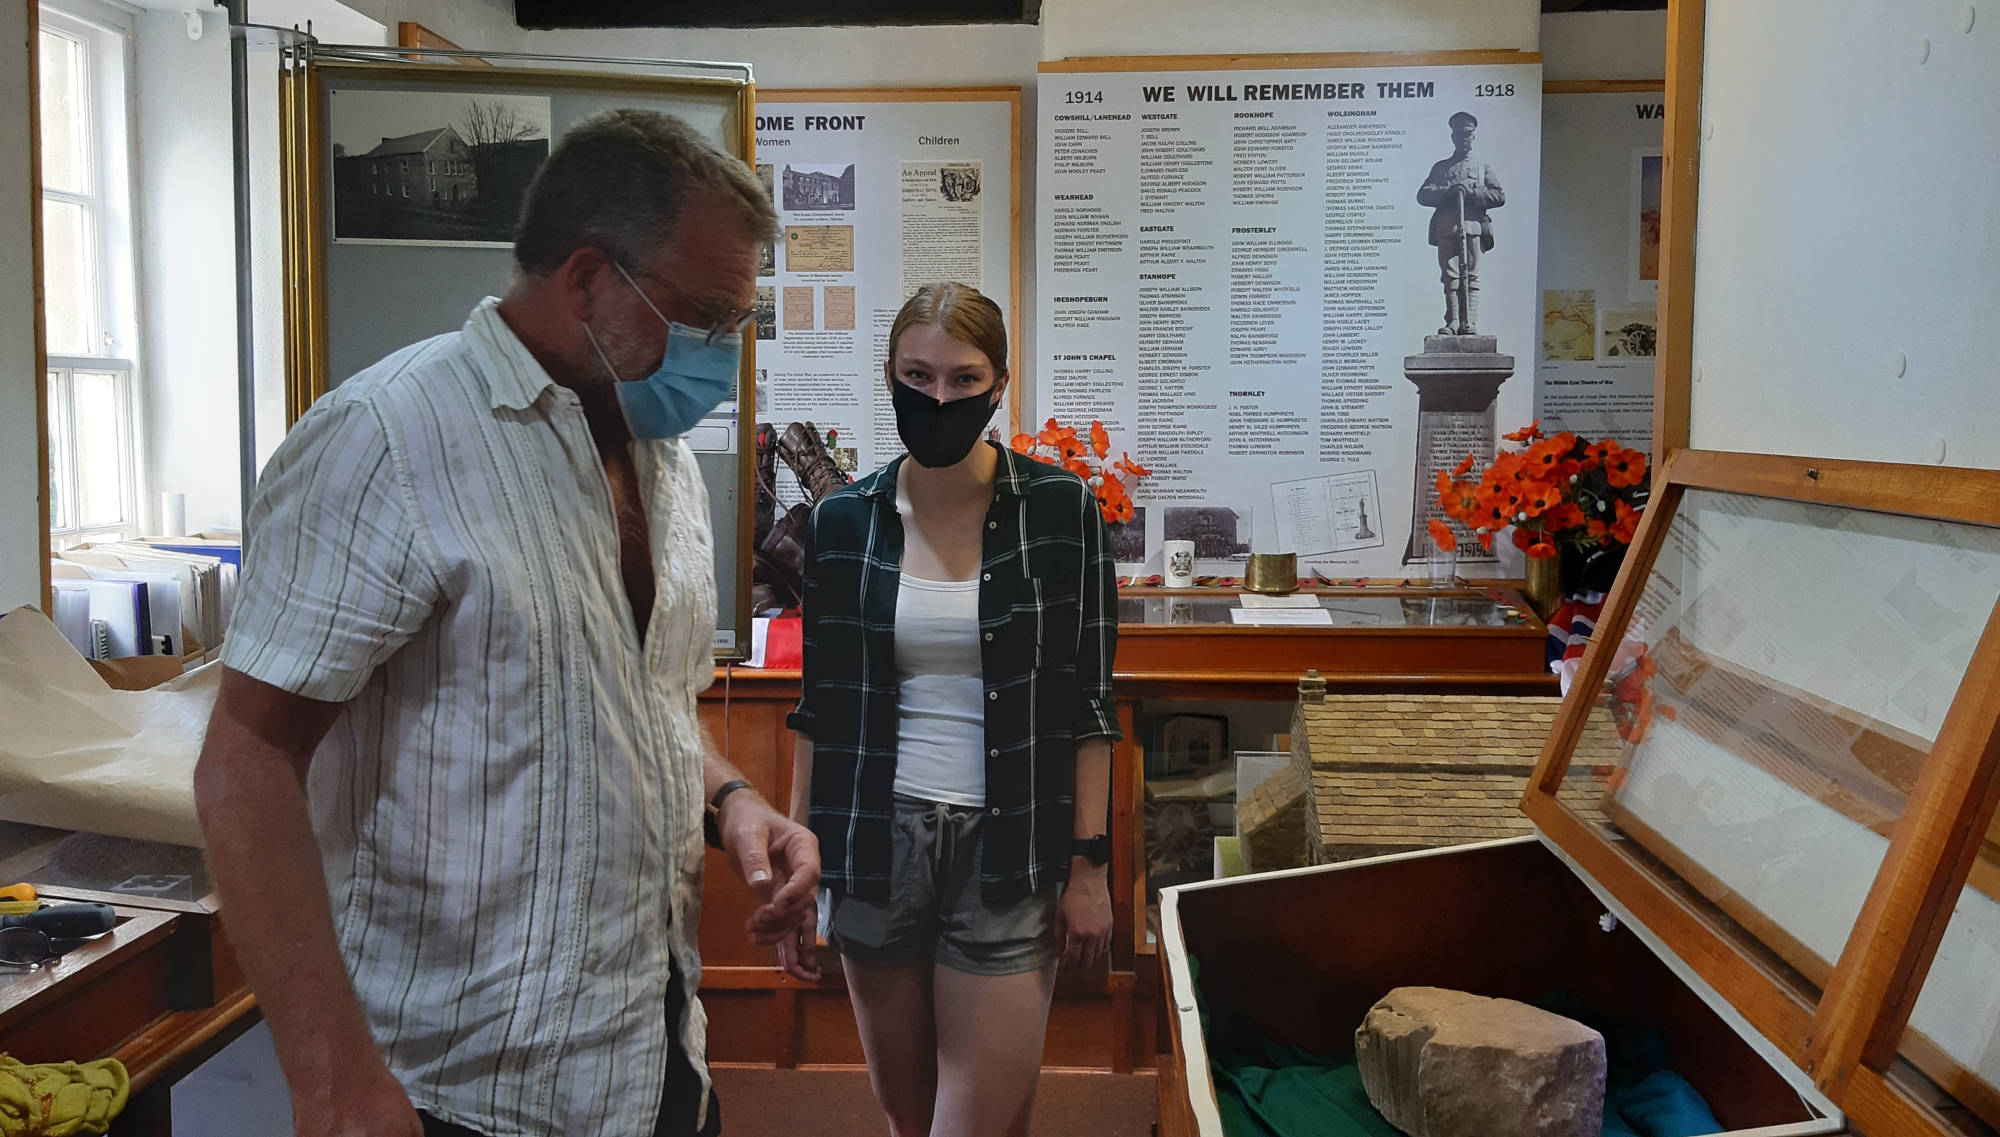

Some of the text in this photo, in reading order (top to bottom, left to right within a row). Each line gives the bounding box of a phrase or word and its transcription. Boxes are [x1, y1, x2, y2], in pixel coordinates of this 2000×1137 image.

[1065, 90, 1103, 104] 1914
[1142, 81, 1434, 103] WE WILL REMEMBER THEM
[1475, 83, 1515, 97] 1918
[1233, 111, 1273, 119] ROOKHOPE
[755, 115, 865, 132] OME FRONT
[918, 135, 959, 145] Children
[1231, 226, 1276, 234] FROSTERLEY
